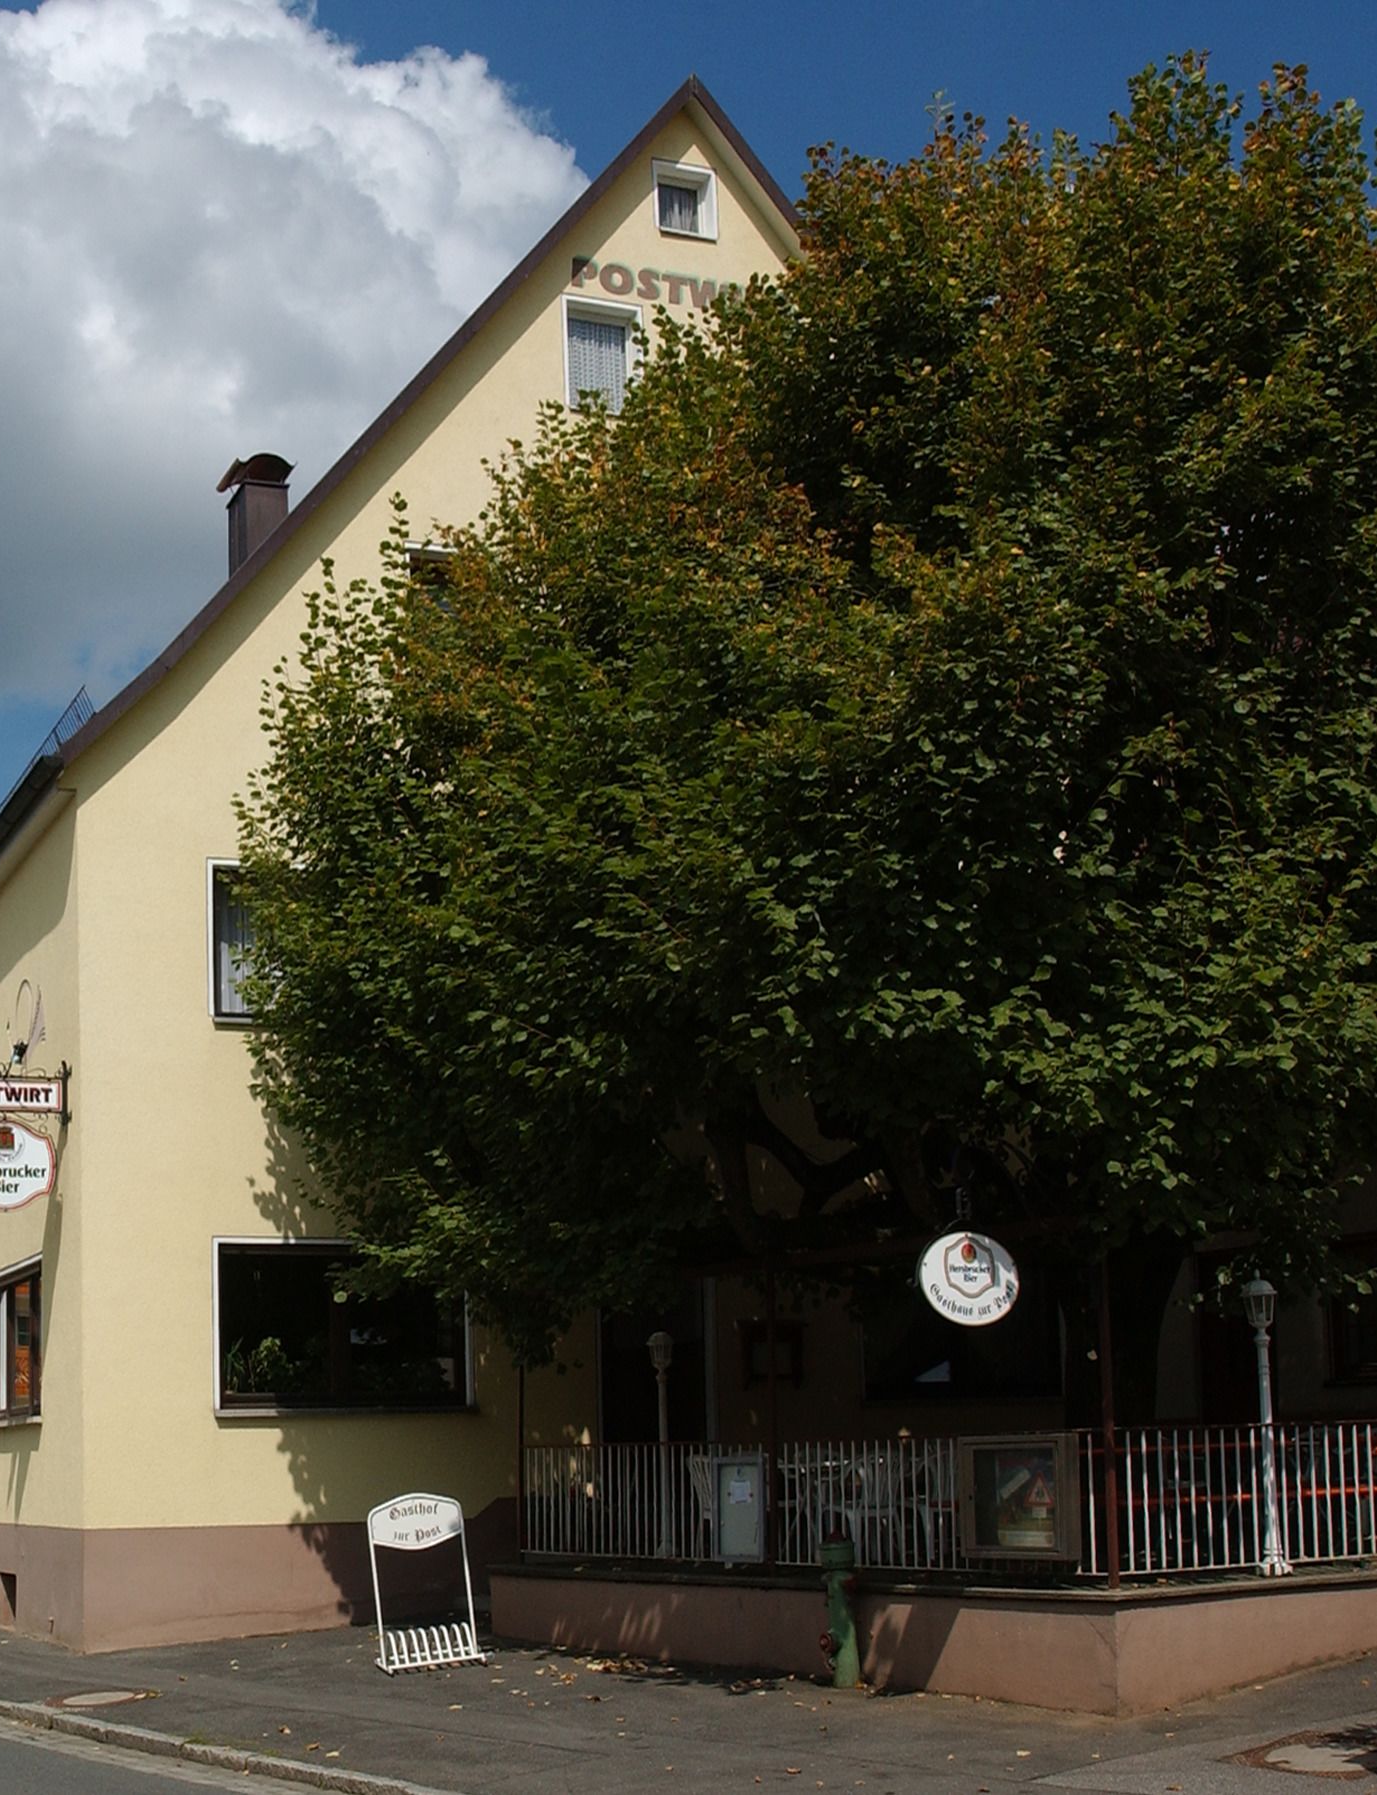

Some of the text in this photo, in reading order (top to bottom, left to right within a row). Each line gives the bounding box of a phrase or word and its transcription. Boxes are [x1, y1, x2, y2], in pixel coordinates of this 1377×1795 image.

[572, 256, 743, 308] POSTW
[949, 1264, 991, 1273] Hersbrucker
[929, 1283, 1015, 1316] Gasthaus zur Post
[389, 1503, 439, 1520] Gasthof
[394, 1526, 442, 1543] zur Post
